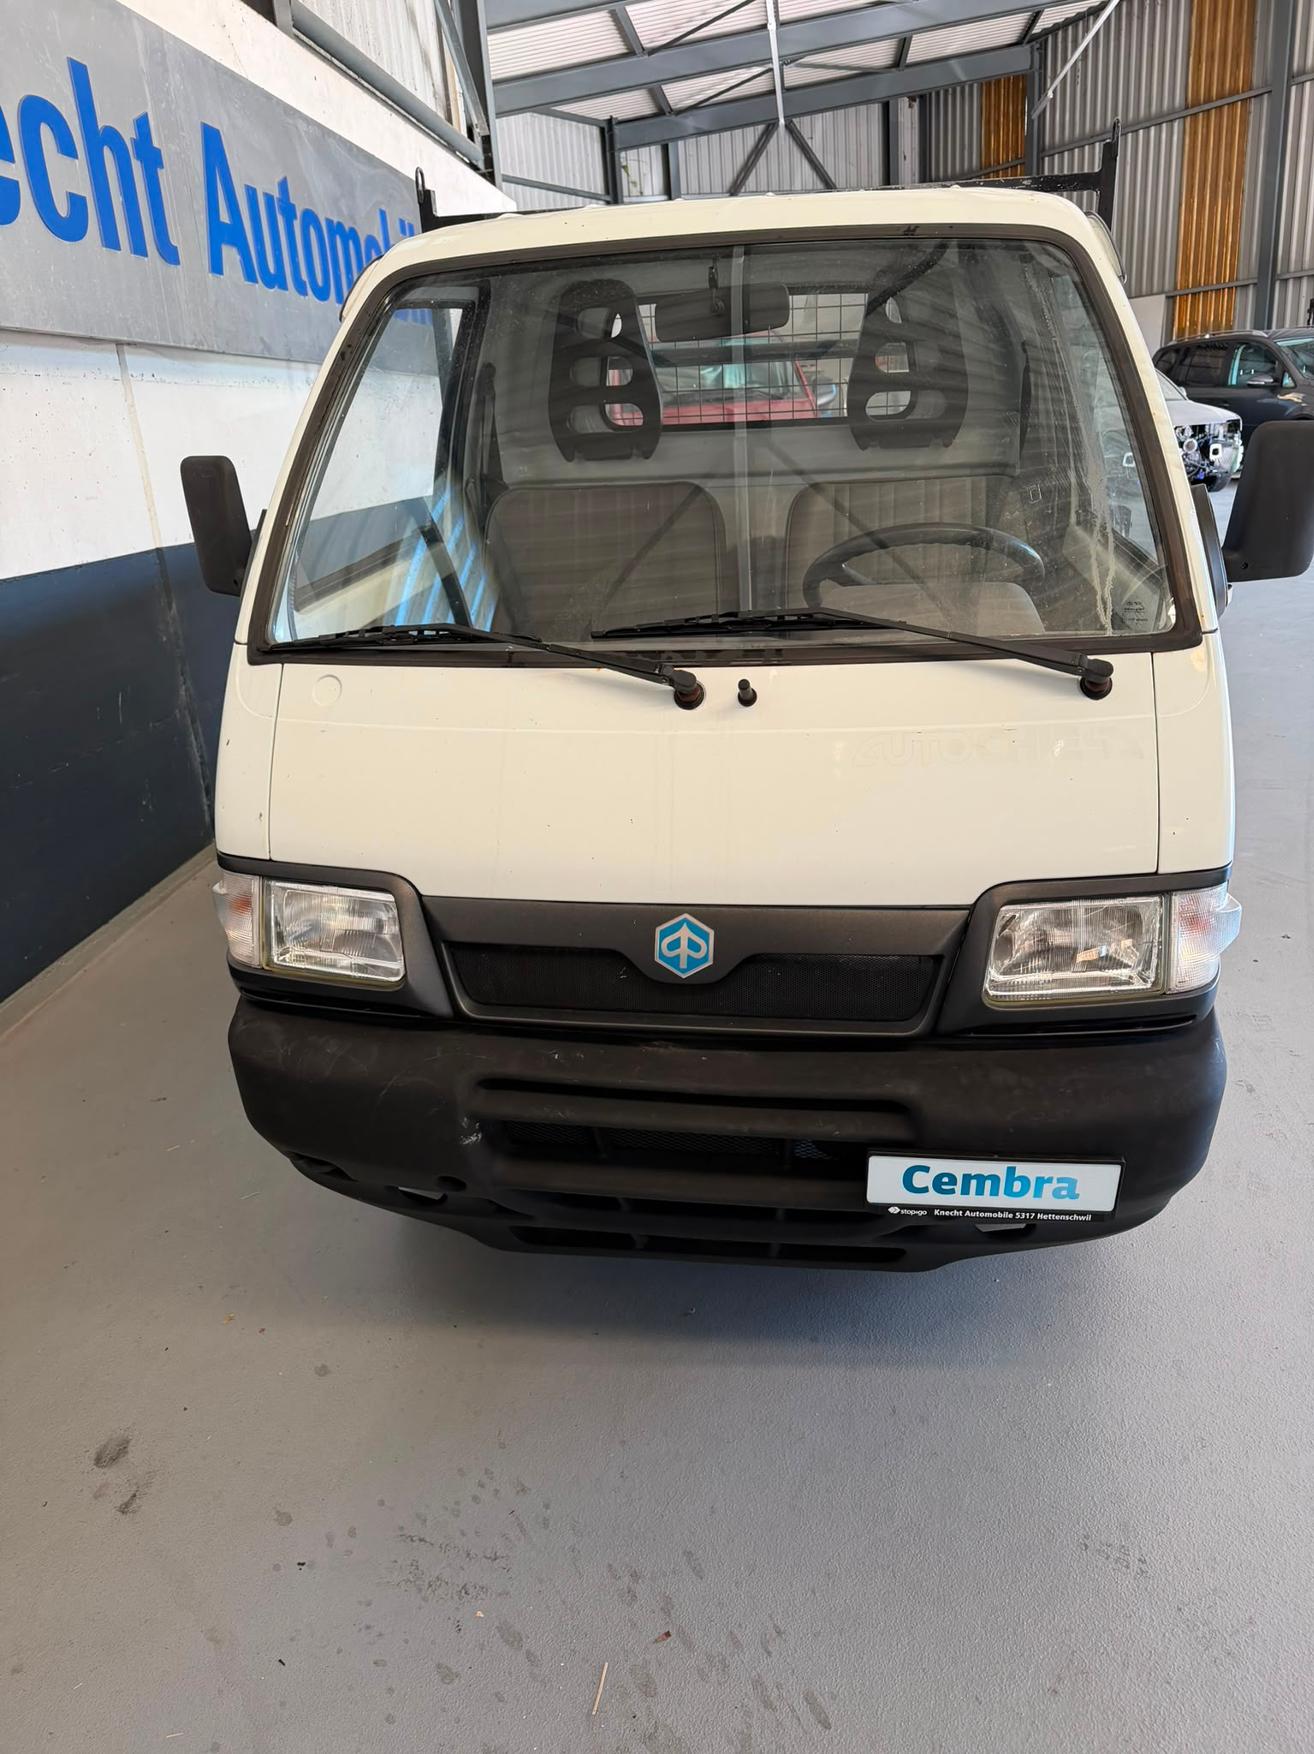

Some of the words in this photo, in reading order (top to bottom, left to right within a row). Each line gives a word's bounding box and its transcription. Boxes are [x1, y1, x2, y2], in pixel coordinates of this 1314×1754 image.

[902, 1164, 1080, 1200] Cembra
[934, 1208, 963, 1217] Knecht
[964, 1210, 1013, 1219] Automobile
